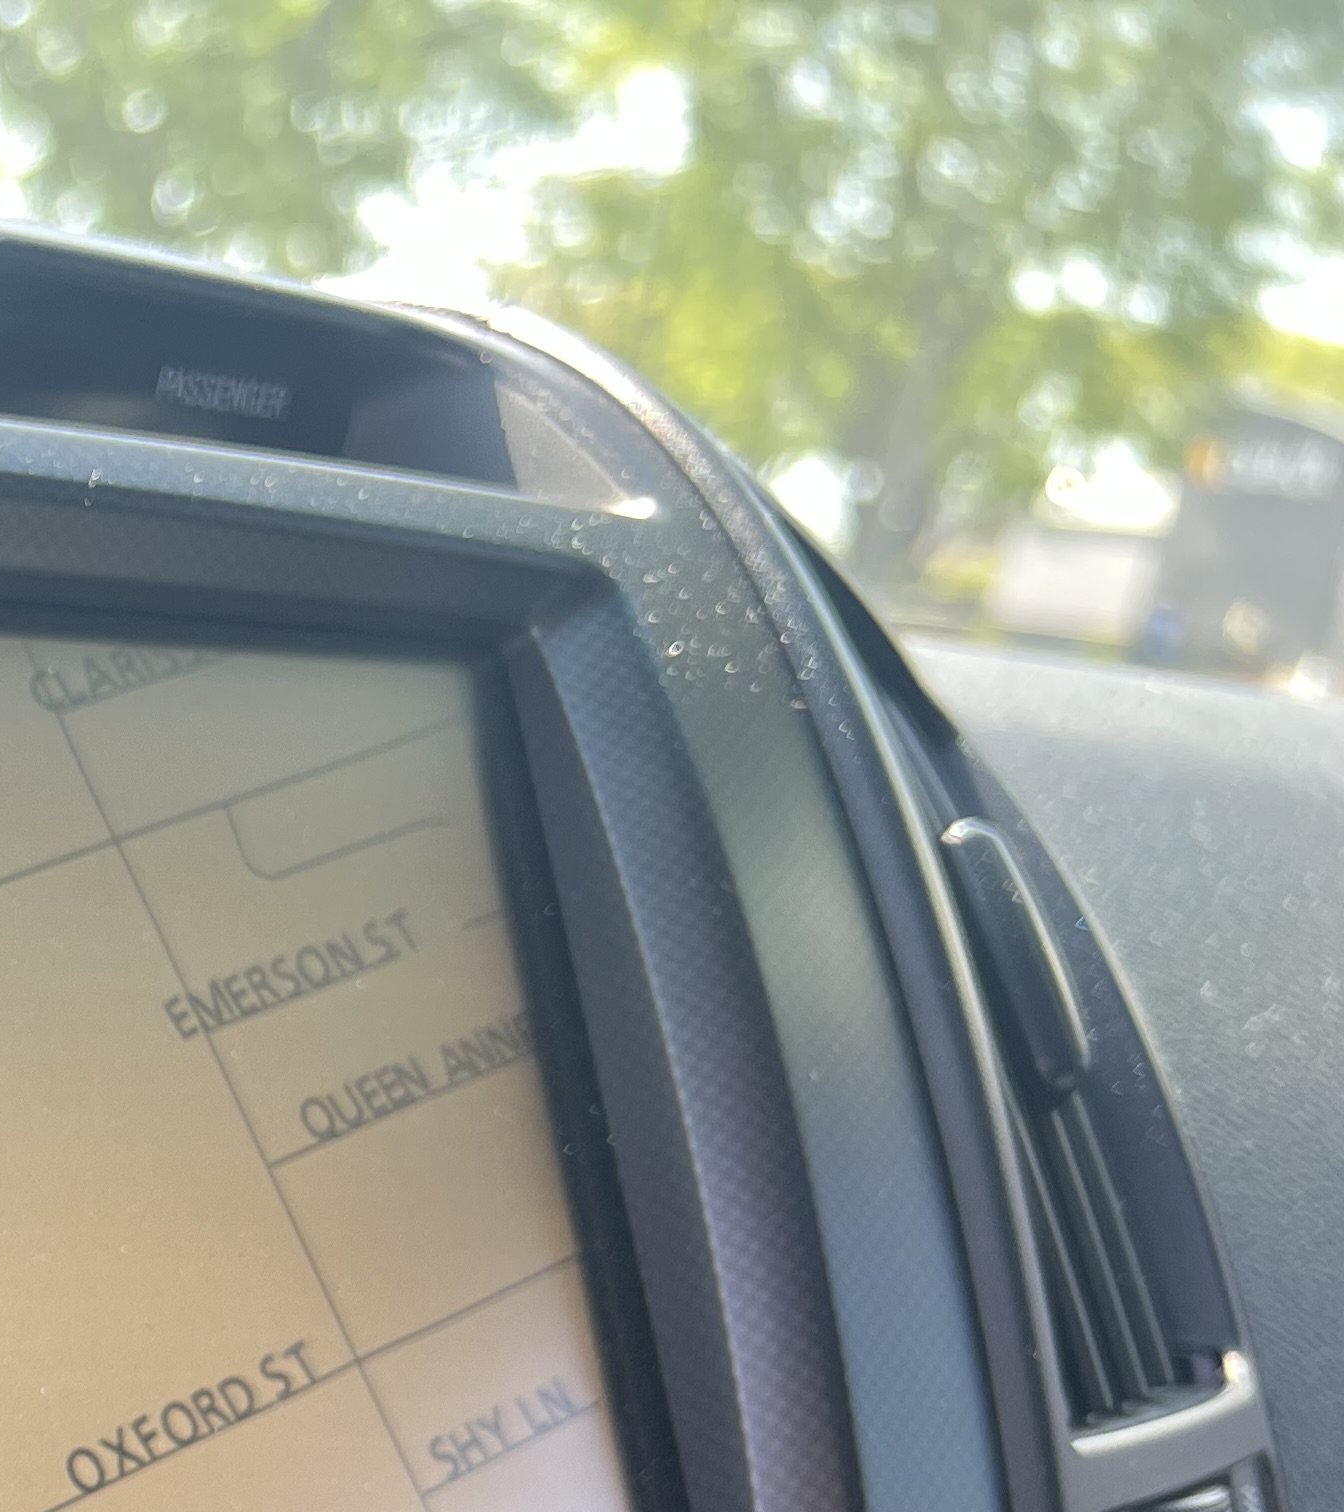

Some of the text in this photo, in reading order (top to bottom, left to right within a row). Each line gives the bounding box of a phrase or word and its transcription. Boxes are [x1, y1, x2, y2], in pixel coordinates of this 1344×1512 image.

[164, 909, 419, 1040] EMERSON ST
[299, 1055, 431, 1143] QUEEN
[65, 1340, 319, 1498] OXFORD ST
[430, 1376, 580, 1477] SHY LN
